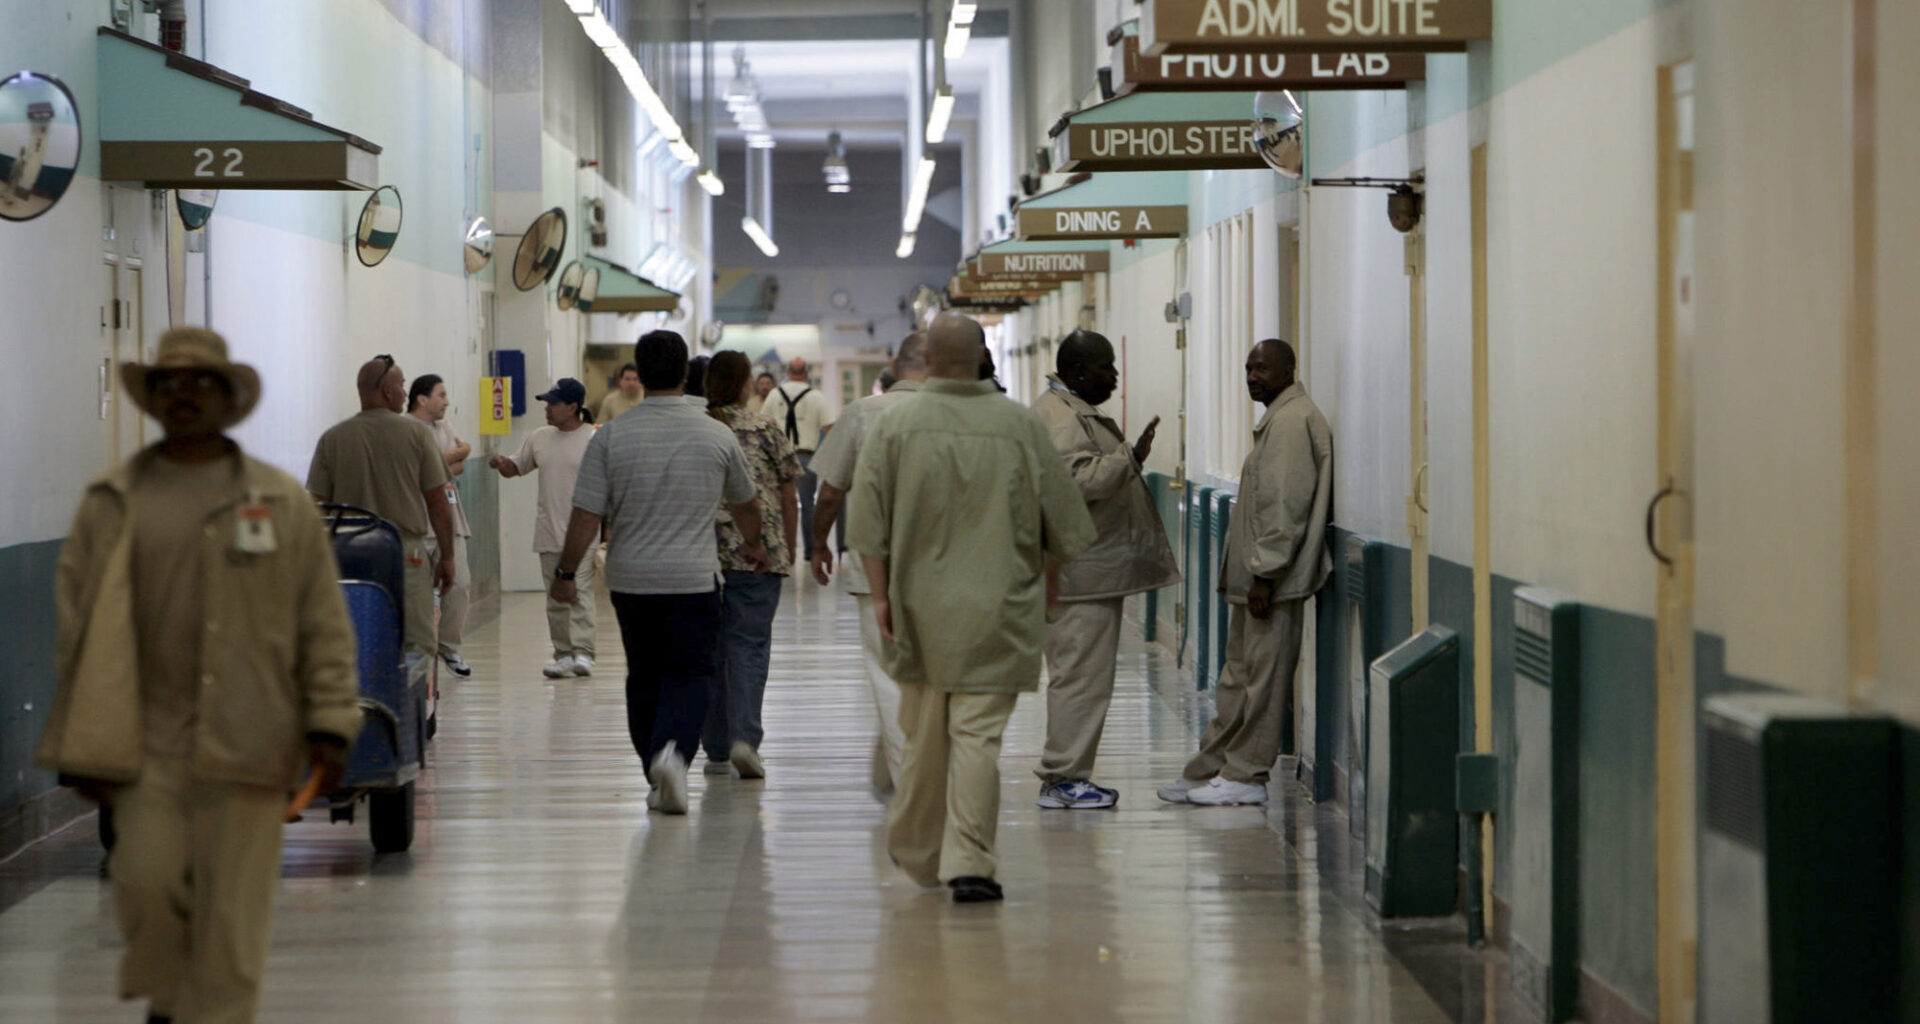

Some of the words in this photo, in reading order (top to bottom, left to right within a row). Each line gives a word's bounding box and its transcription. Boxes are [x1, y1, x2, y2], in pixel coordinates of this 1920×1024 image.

[1196, 0, 1305, 36] ADMI.
[1326, 0, 1441, 36] SUITE
[1310, 53, 1390, 77] LAB
[194, 147, 245, 177] 22
[1056, 210, 1121, 233] DINING
[1134, 209, 1152, 231] A
[1004, 253, 1086, 273] NUTRITION
